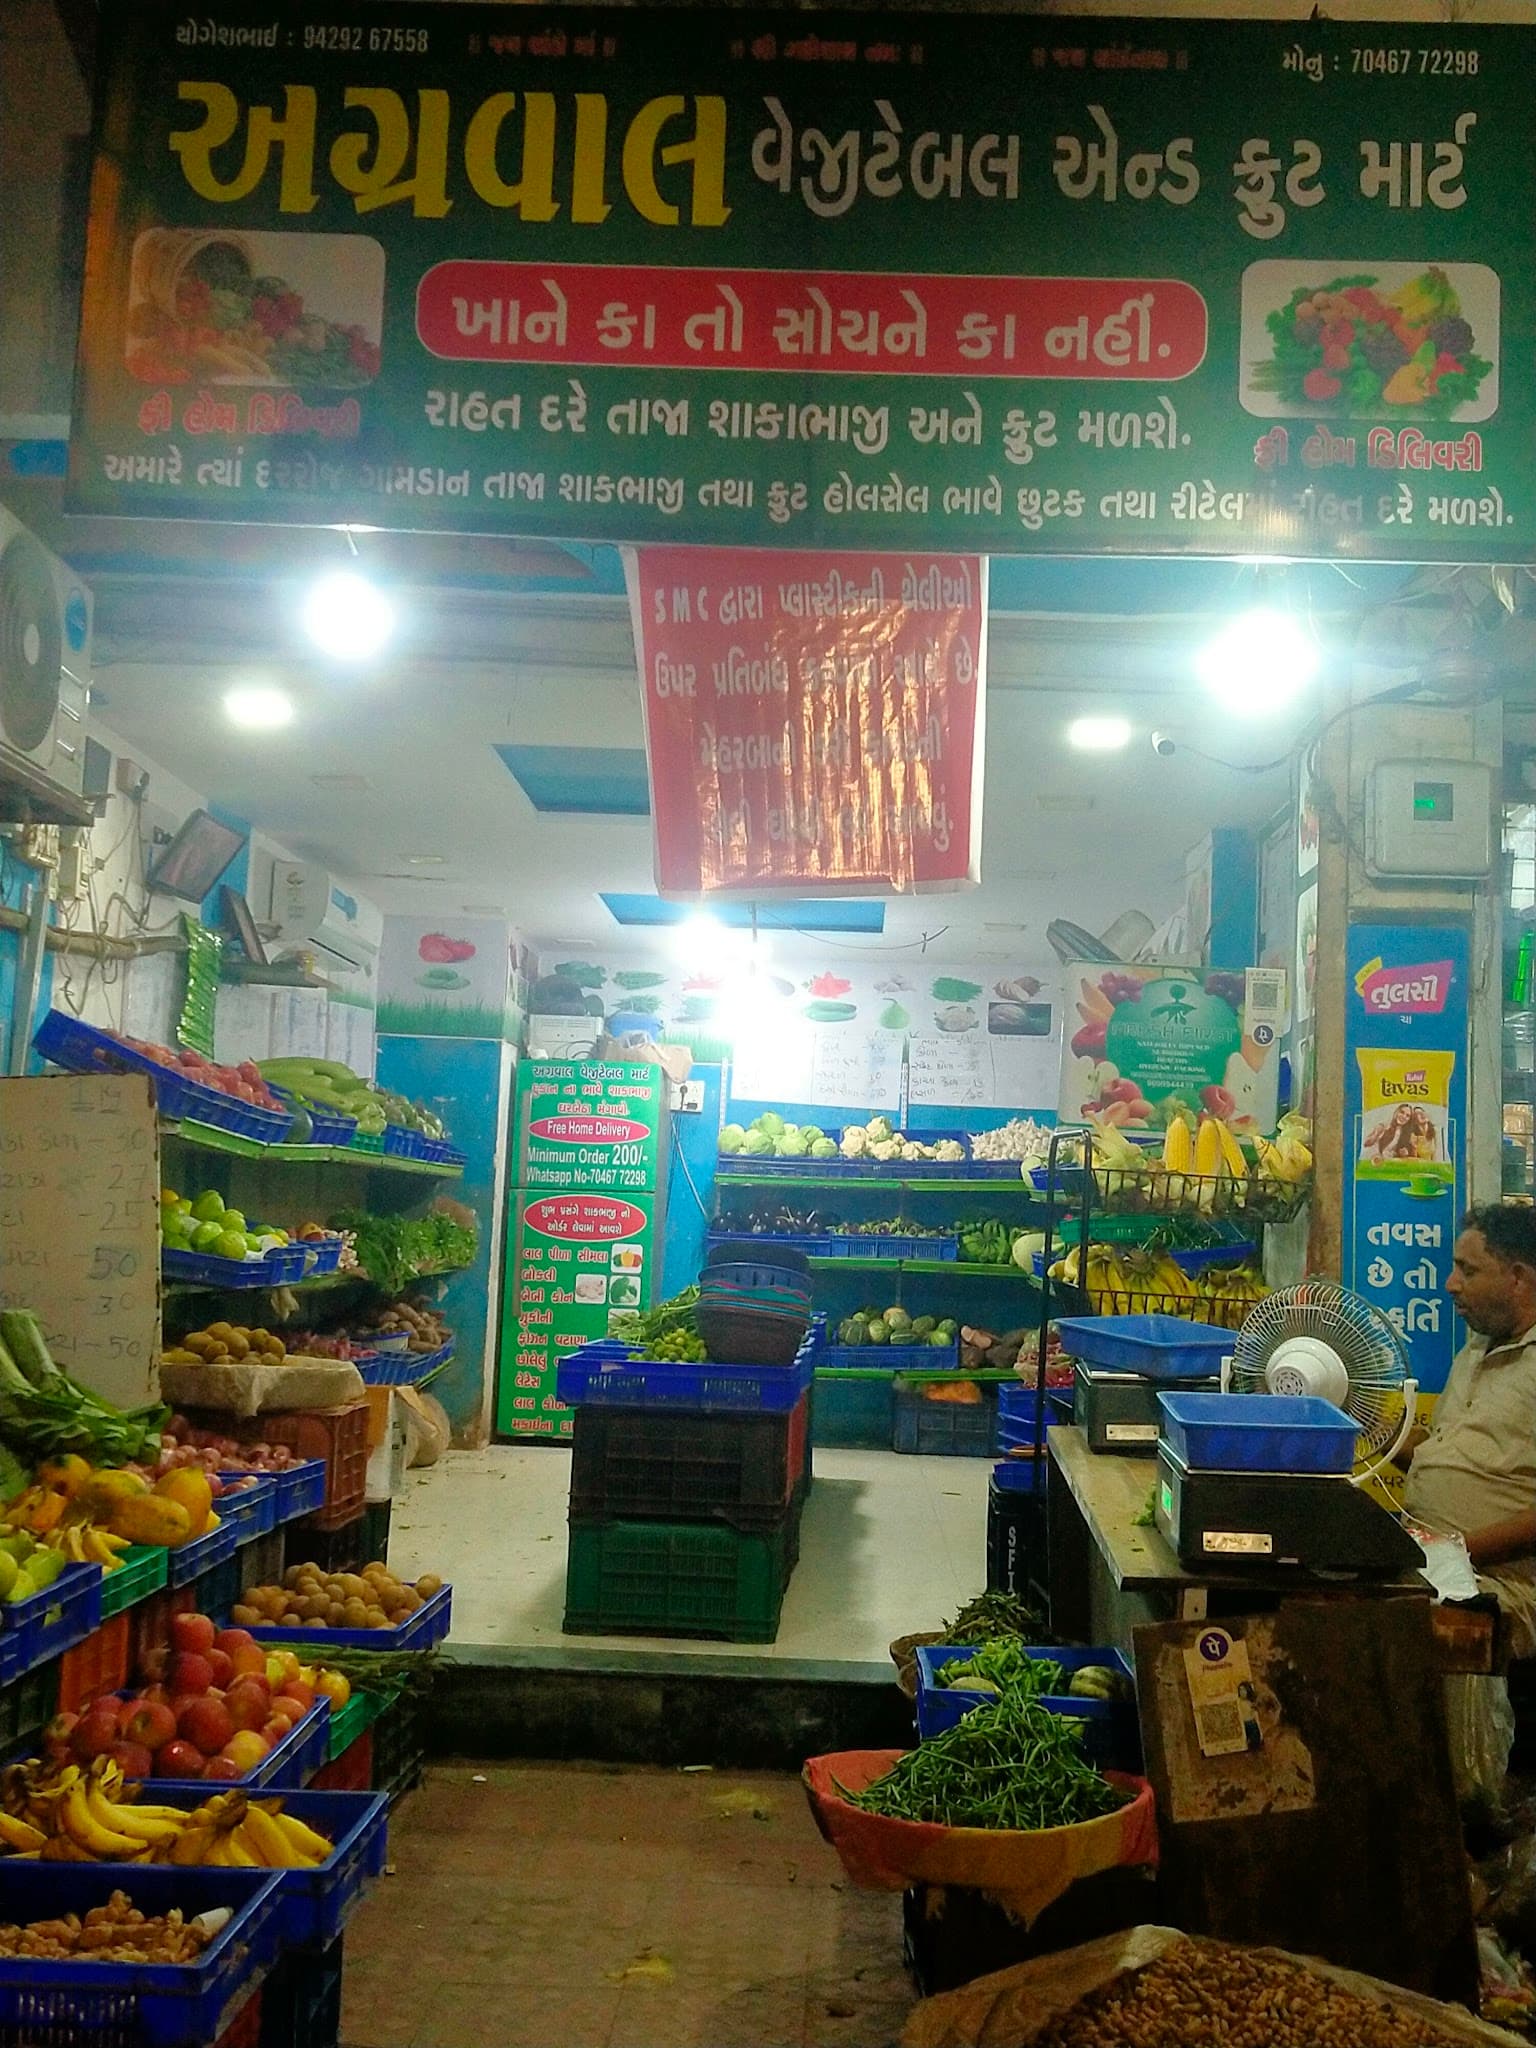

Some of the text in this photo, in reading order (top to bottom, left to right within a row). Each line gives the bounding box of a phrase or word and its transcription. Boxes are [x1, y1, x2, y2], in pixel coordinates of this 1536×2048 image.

[303, 25, 362, 51] 94292
[368, 28, 429, 53] 67558
[1281, 48, 1325, 82] મોનુ
[1350, 48, 1413, 75] 70467
[1418, 49, 1480, 76] 72298
[168, 80, 732, 227] અગ્રવાલ
[750, 97, 1020, 217] વેજીટેબલ
[1052, 104, 1201, 206] એન્ડ
[1359, 111, 1478, 210] માર્ટ
[450, 279, 568, 347] ખાને
[595, 301, 655, 350] કા
[684, 284, 743, 352] તો
[956, 312, 1015, 360] કા
[424, 388, 522, 432] રાહત
[538, 379, 587, 434] દરે
[605, 399, 689, 437] તાજા
[909, 391, 984, 446] અને
[1078, 396, 1191, 449] મળશે.
[1367, 427, 1484, 472] ડિલિવરી
[102, 445, 184, 485] અમારે
[483, 471, 545, 500] તાજા
[697, 479, 753, 507] તથા
[822, 470, 929, 514] હોલસેલ
[943, 474, 1002, 516] ભાવે
[1099, 490, 1156, 520] તથા
[1428, 486, 1514, 527] મળશે.
[655, 651, 697, 700] ઉપર
[1380, 1077, 1430, 1097] tavas
[547, 1120, 631, 1140] Free Home Delivery
[528, 1144, 649, 1167] Minimum Order 200/-
[527, 1167, 571, 1187] Whatsapp
[619, 1169, 647, 1187] 72298
[1367, 1222, 1442, 1248] તવસ
[522, 1248, 543, 1260] લાલ
[577, 1246, 609, 1263] સીમલા
[1367, 1256, 1438, 1290] છે તો
[513, 1396, 536, 1410] લાલ
